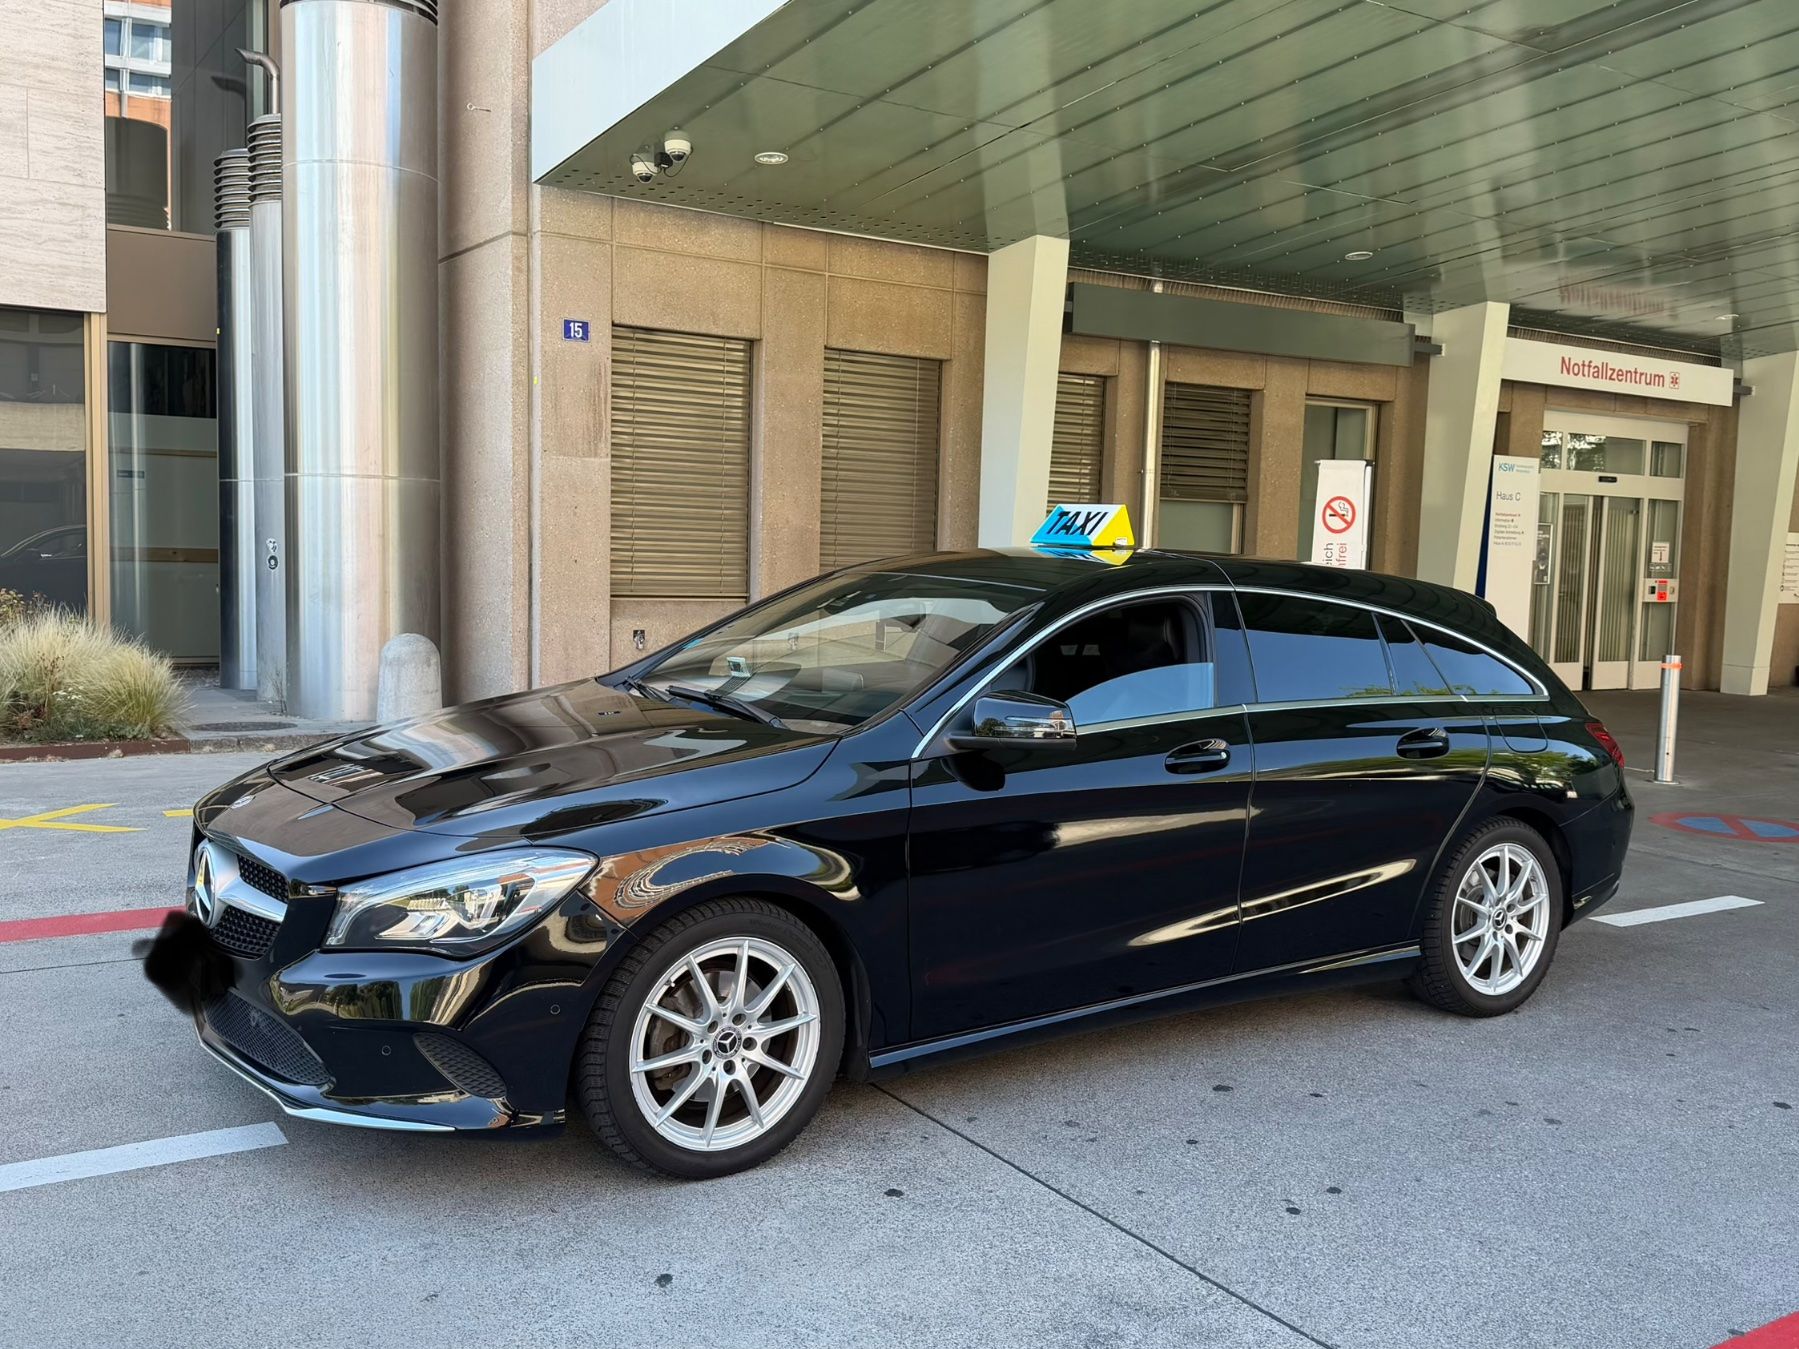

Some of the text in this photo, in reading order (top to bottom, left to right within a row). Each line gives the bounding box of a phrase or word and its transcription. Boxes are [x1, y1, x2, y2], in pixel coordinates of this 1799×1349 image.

[570, 322, 583, 338] 15
[1560, 356, 1665, 388] Notfallzentrum
[1499, 463, 1515, 472] KSW
[1496, 491, 1521, 501] Haus C
[1046, 511, 1109, 535] TAXI
